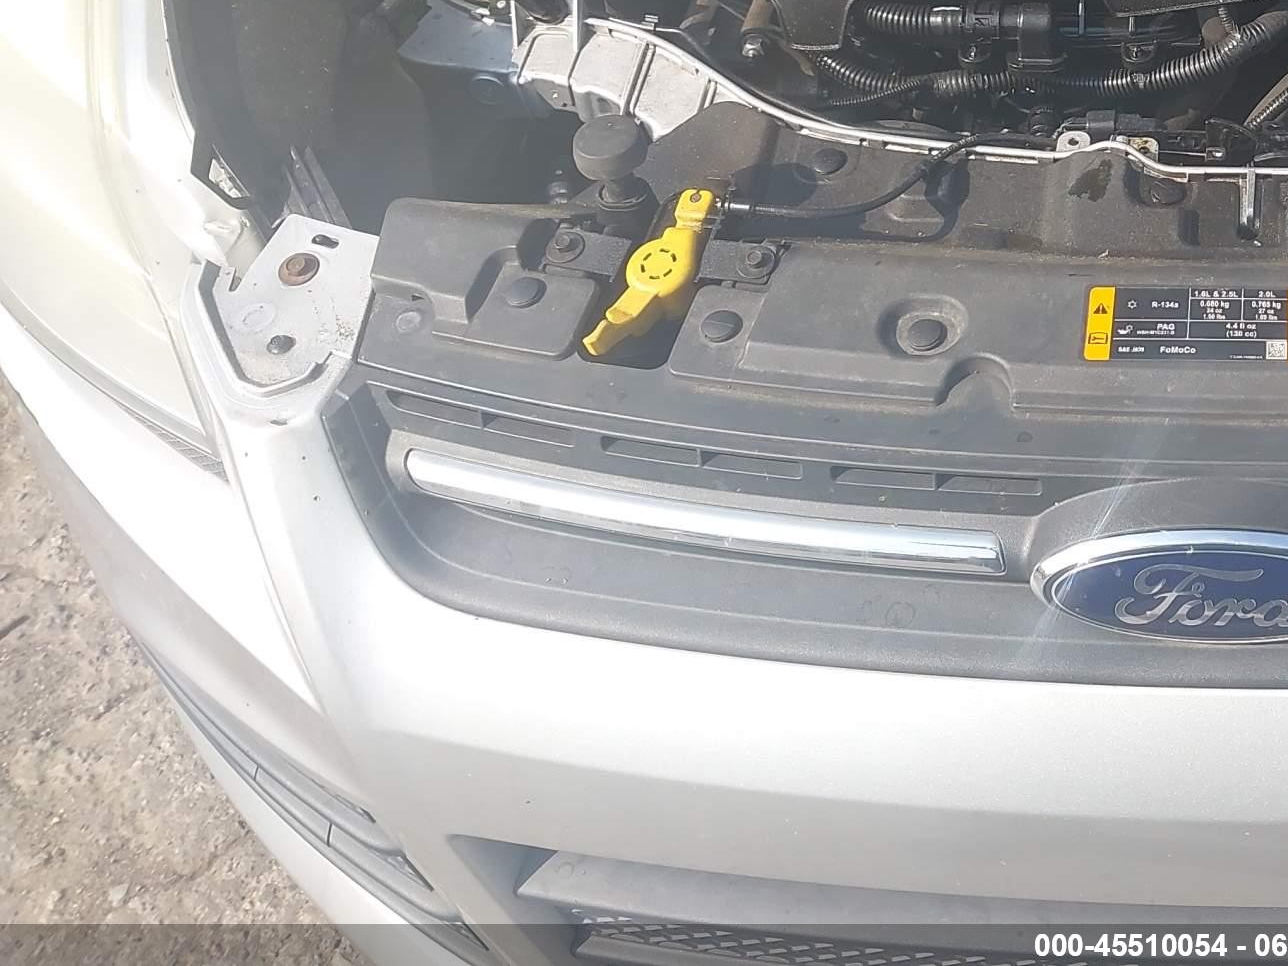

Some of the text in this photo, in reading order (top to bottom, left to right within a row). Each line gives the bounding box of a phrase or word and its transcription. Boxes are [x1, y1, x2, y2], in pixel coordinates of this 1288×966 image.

[1194, 290, 1238, 298] 1.6L & 2.5L
[1258, 290, 1276, 298] 2.0L
[1151, 301, 1179, 309] R-134a
[1220, 300, 1230, 309] kg
[1272, 300, 1281, 310] kg
[1159, 345, 1196, 355] FoMoCo
